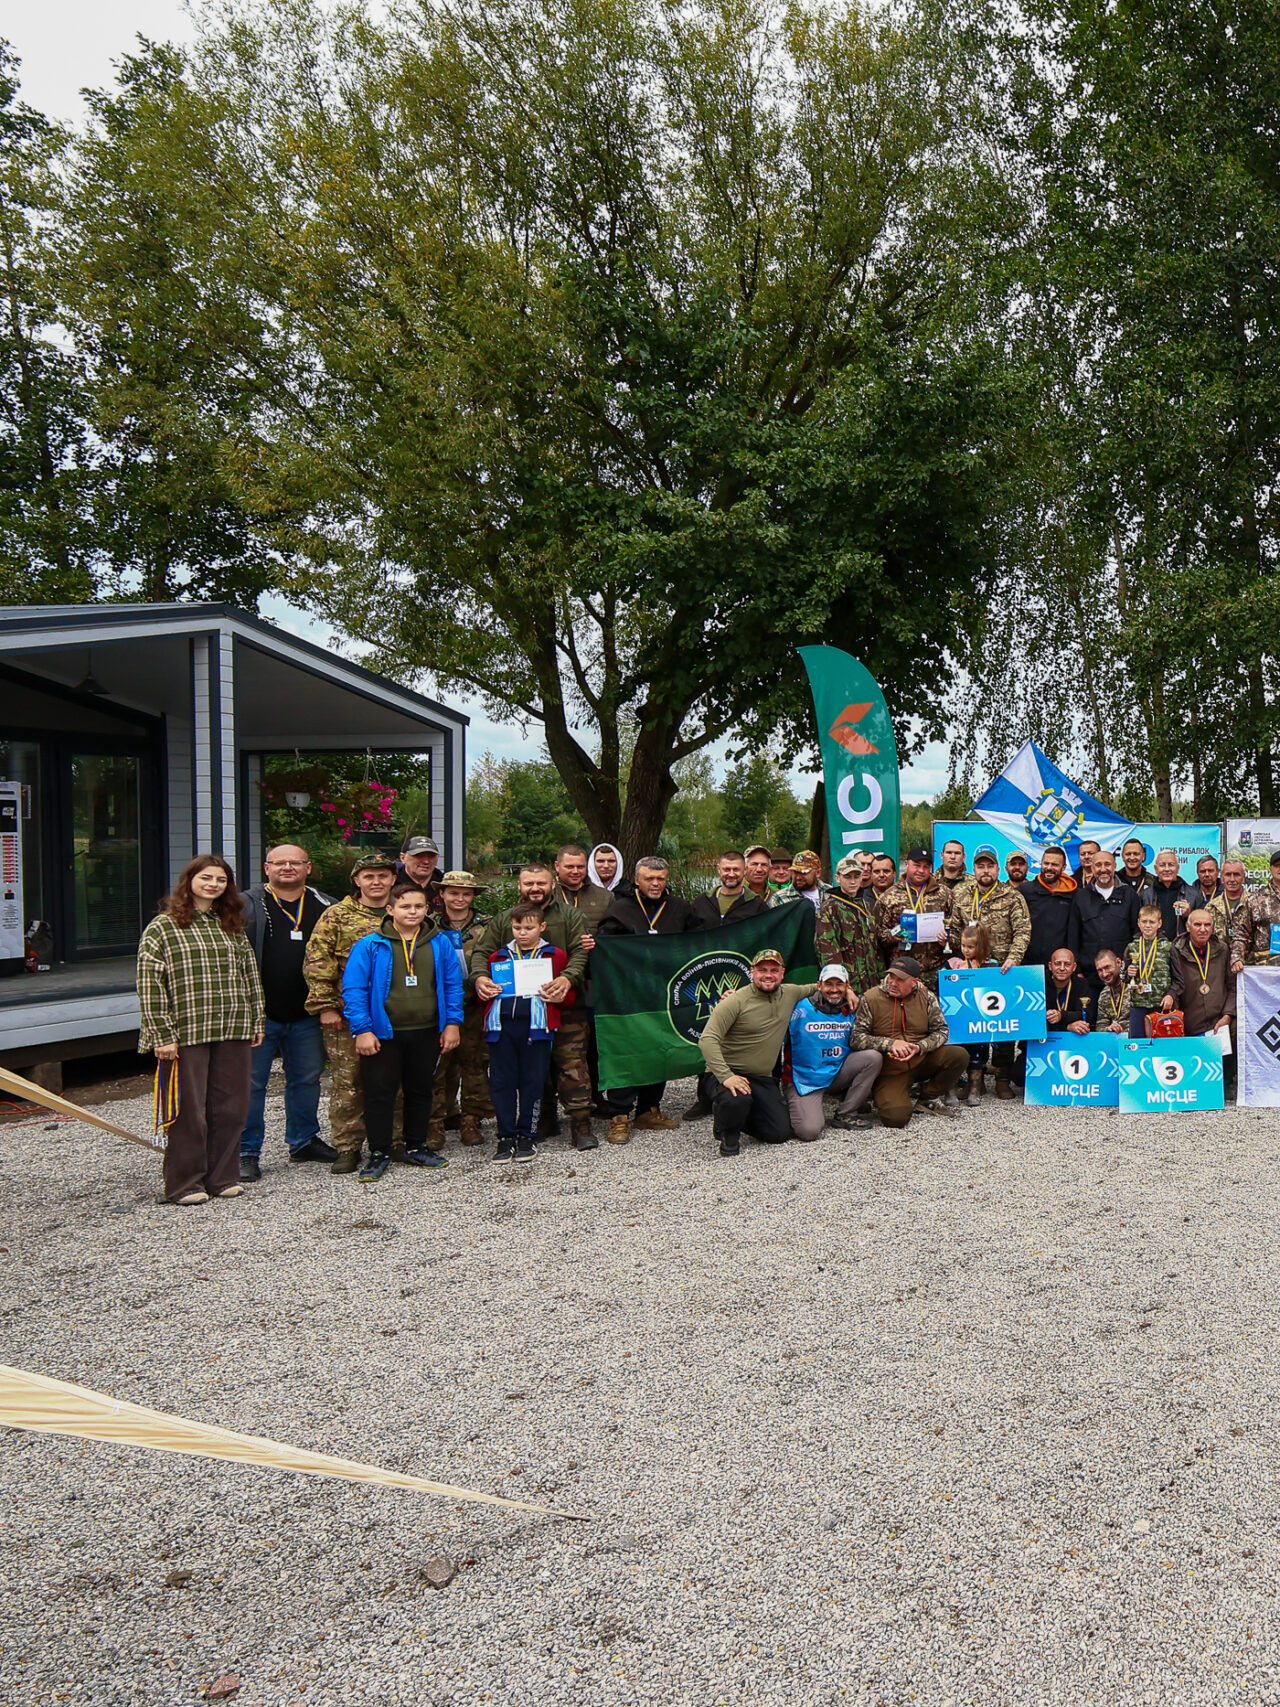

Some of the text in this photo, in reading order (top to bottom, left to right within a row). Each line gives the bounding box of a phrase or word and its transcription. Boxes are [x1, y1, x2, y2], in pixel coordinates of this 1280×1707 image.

[1178, 846, 1210, 855] РИБАЛОК
[673, 980, 683, 1006] СПІЛКА
[986, 995, 1000, 1011] 2
[808, 1022, 851, 1031] ГОЛОВНИЙ
[968, 1019, 1020, 1034] МІСЦЕ
[821, 1047, 840, 1058] FCU
[1070, 1059, 1080, 1075] 1
[1164, 1065, 1178, 1081] 3
[1051, 1084, 1100, 1099] МІСЦЕ
[1146, 1089, 1198, 1104] МІСЦЕ
